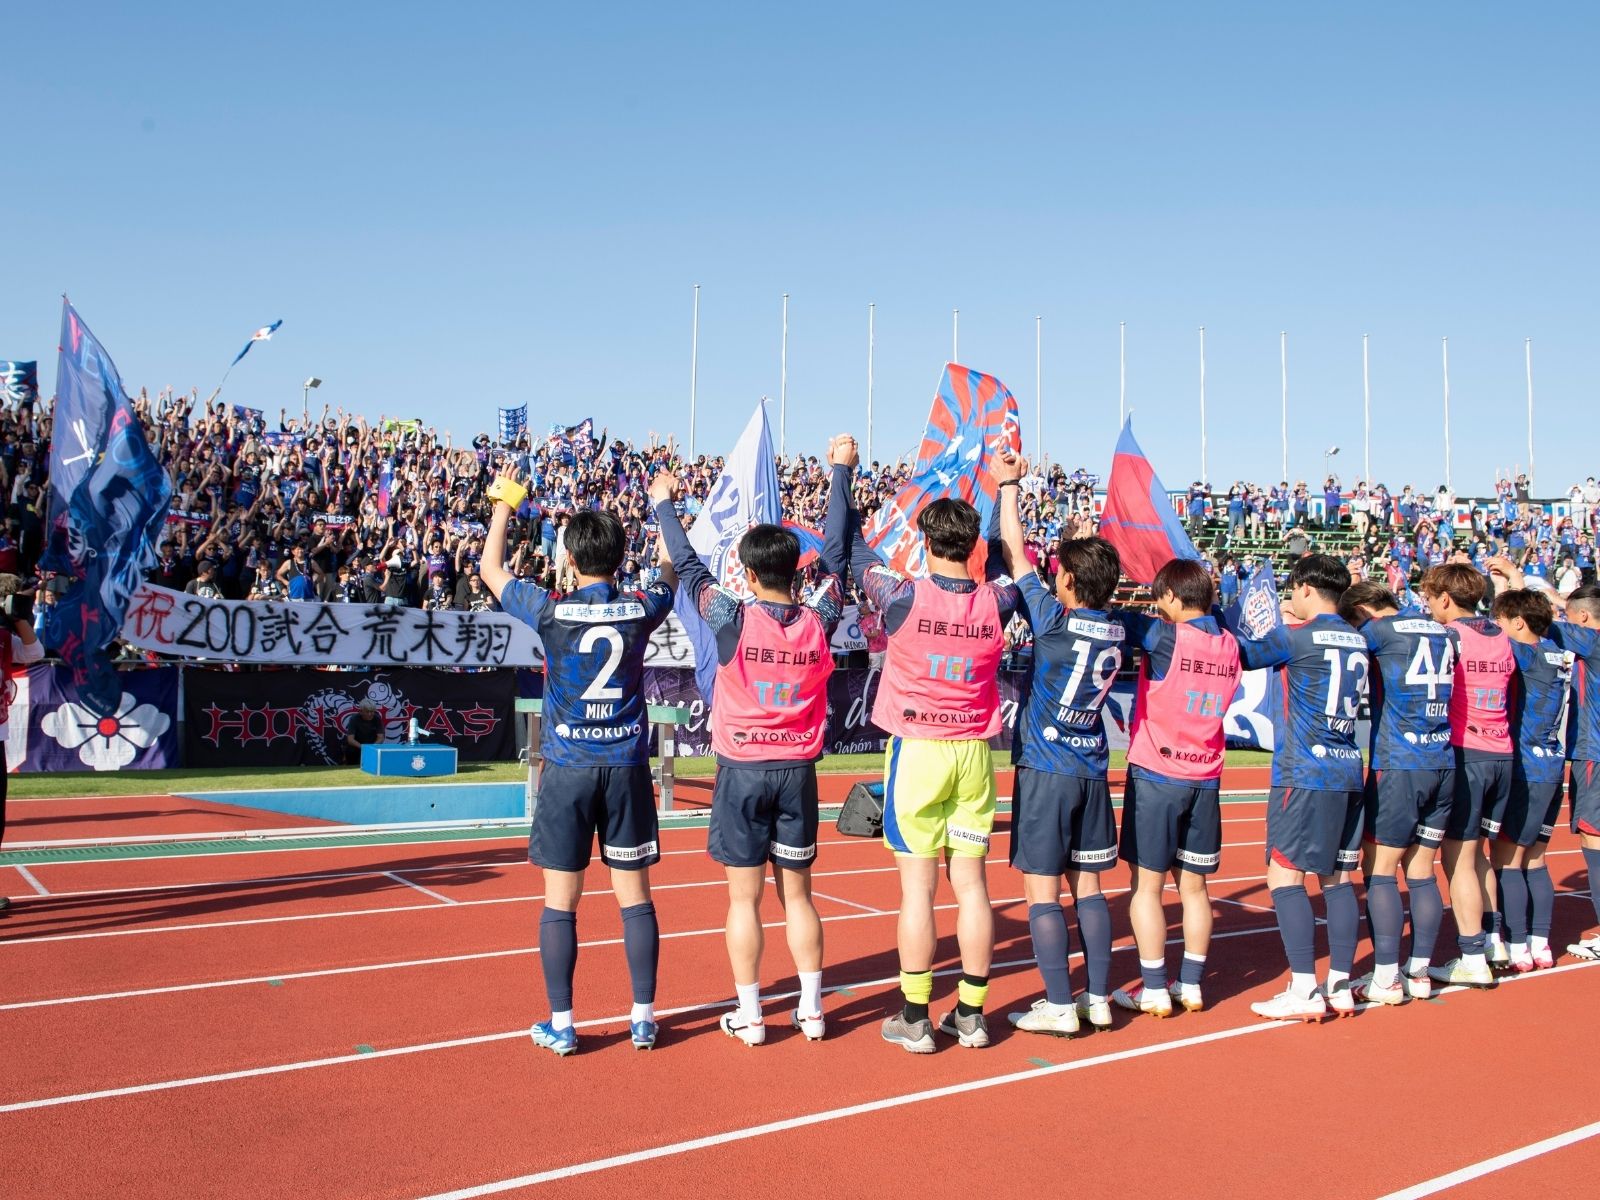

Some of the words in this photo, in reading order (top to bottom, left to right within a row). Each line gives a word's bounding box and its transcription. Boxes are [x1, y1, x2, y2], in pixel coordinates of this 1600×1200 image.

[917, 618, 994, 640] 日医工山梨
[579, 626, 624, 699] 2
[745, 646, 821, 666] 日医工山梨
[1467, 660, 1512, 673] 日医工山梨
[1059, 640, 1122, 710] 19
[1180, 658, 1238, 680] 日医工山梨
[1324, 649, 1369, 719] 13
[585, 703, 614, 719] MIKI
[1185, 689, 1226, 717] TEL
[1057, 706, 1098, 728] HAYATA
[572, 724, 641, 739] KYOKUYO
[751, 731, 813, 743] KYOKUYO
